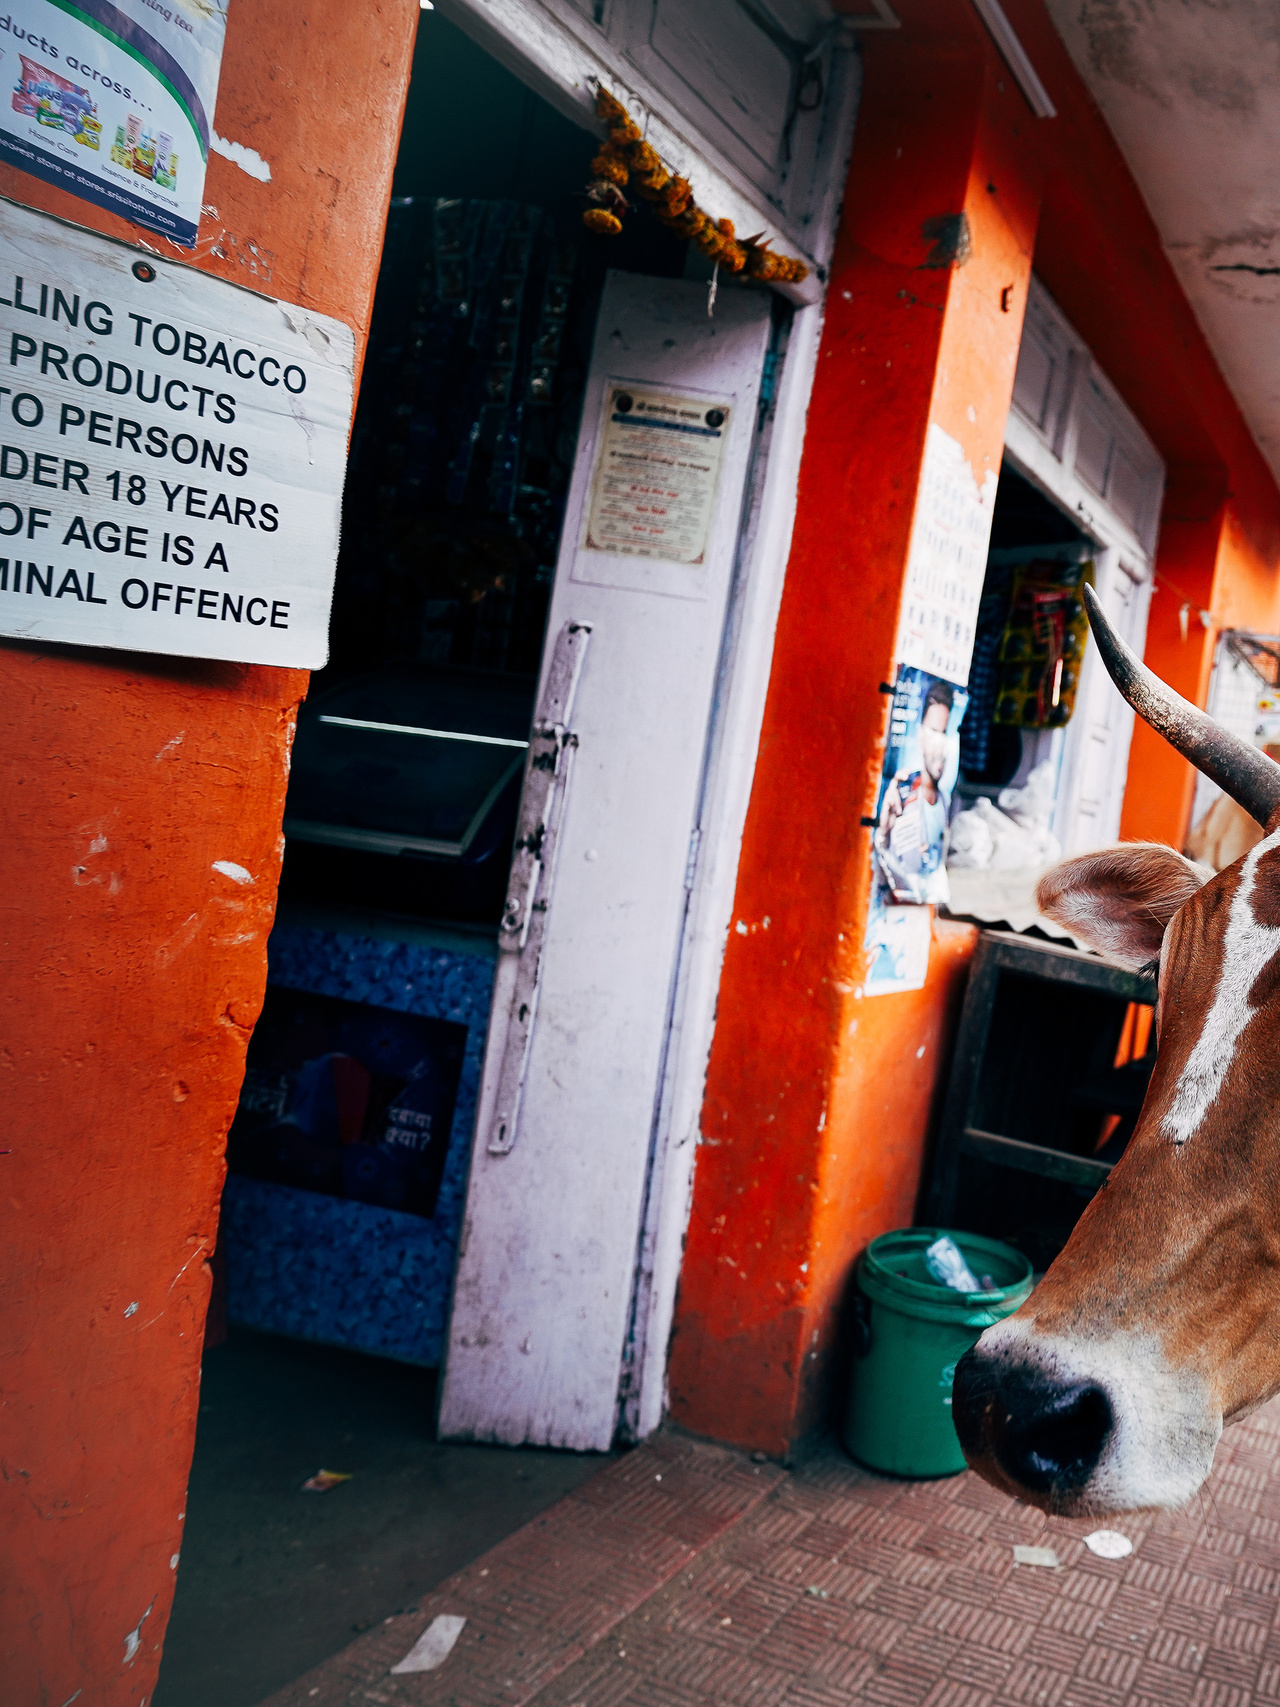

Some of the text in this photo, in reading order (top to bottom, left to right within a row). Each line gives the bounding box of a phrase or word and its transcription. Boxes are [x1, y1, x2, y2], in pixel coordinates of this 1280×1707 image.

[174, 14, 193, 34] tea
[28, 127, 78, 158] Home Care
[36, 156, 62, 173] store
[64, 169, 76, 180] at
[133, 180, 140, 189] &
[141, 183, 179, 208] Fragrance
[10, 332, 236, 424] PRODUCTS
[128, 312, 306, 394] TOBACCO
[59, 403, 249, 477] PERSONS
[0, 445, 279, 532] DER 18 YEARS
[0, 502, 229, 572] OF AGE IS A
[121, 578, 290, 629] OFFENCE
